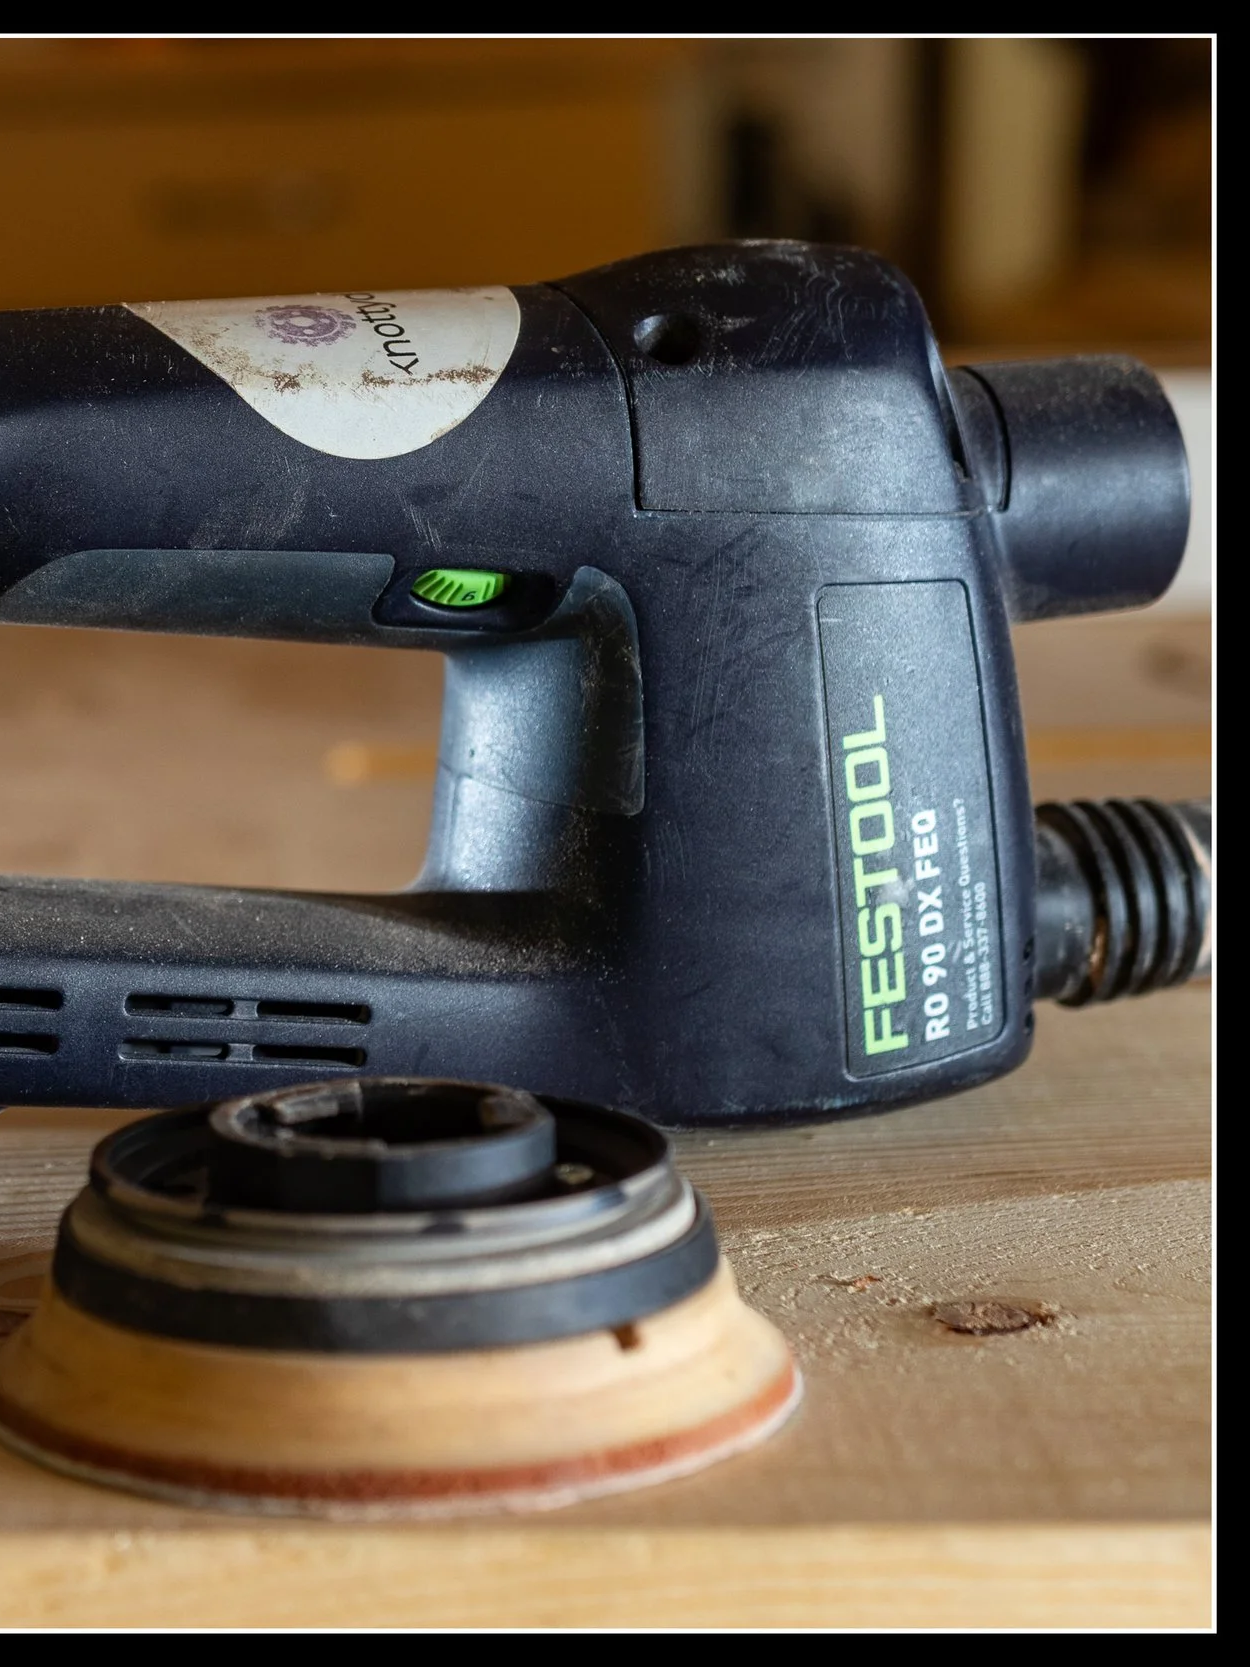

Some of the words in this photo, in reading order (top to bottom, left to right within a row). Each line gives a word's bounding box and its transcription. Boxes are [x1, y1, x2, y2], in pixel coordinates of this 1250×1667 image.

[911, 808, 942, 881] FEQ
[952, 798, 971, 888] Questions?
[842, 694, 909, 1056] FESTOOL
[917, 885, 944, 936] DX
[962, 889, 975, 950] Service
[921, 942, 948, 986] 90
[963, 954, 975, 965] &
[923, 992, 950, 1042] RO
[964, 968, 978, 1030] Product
[980, 992, 993, 1026] Call
